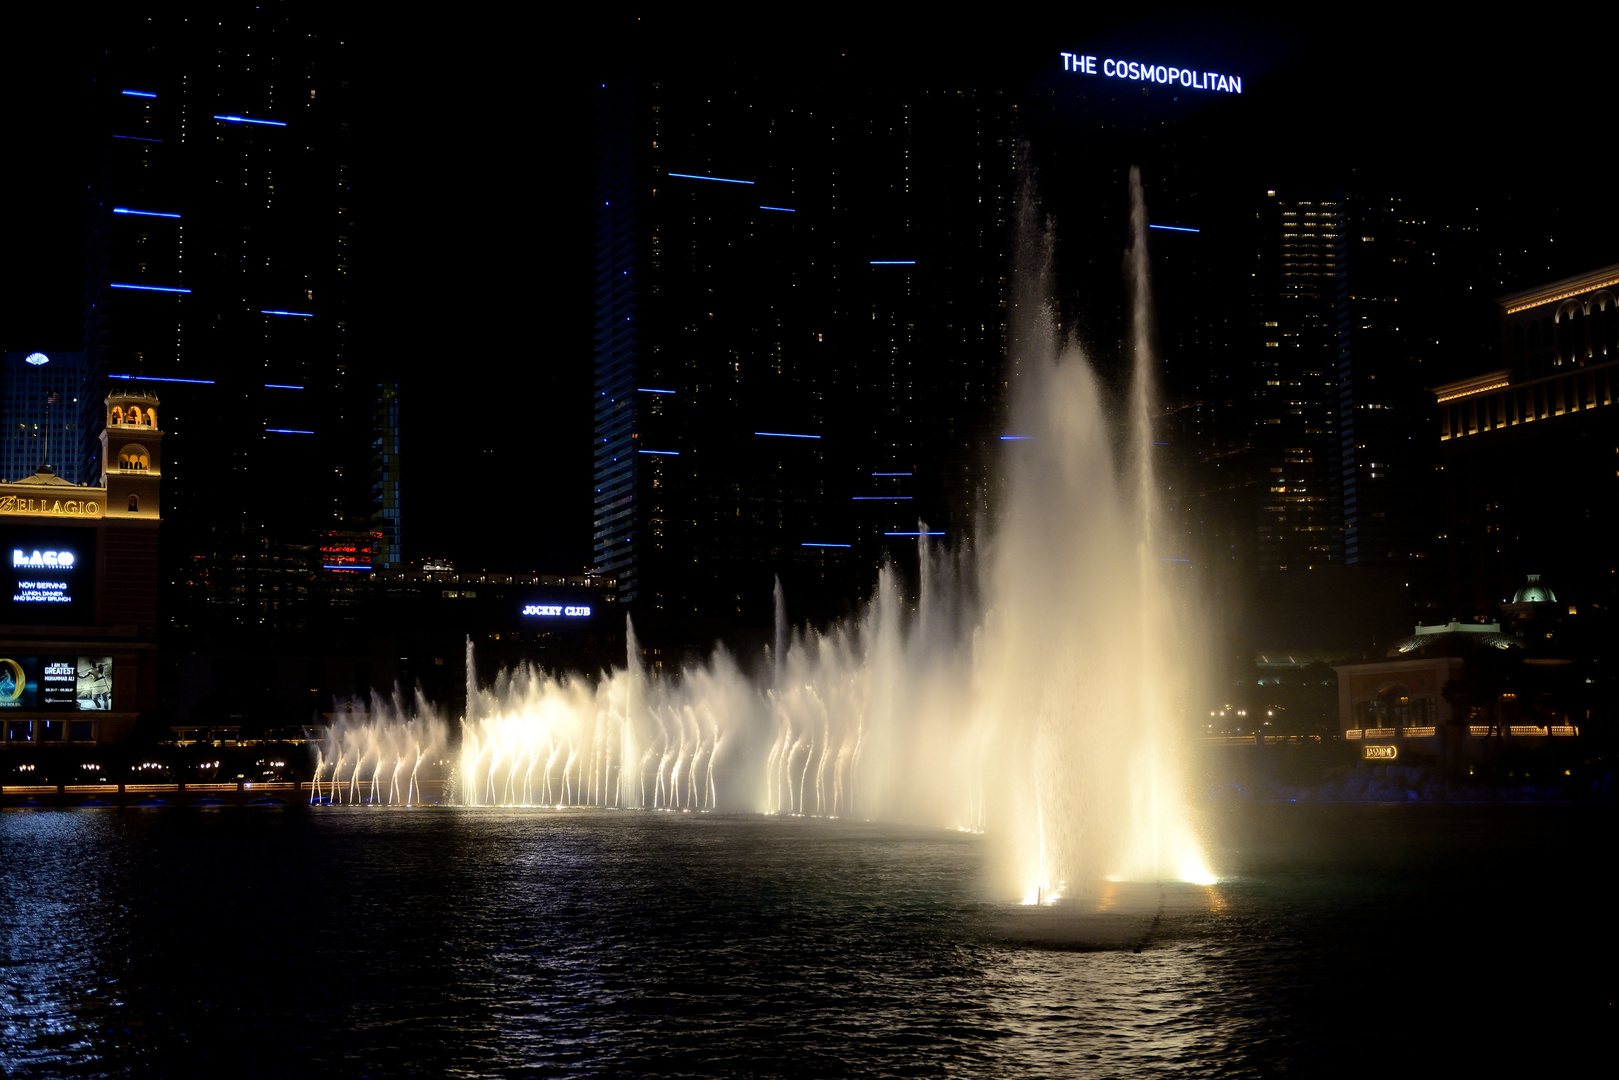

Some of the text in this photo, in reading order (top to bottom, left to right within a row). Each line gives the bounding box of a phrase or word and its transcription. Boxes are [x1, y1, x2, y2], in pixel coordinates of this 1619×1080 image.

[1060, 52, 1242, 94] THE COSMOPOLITAN
[0, 495, 100, 515] BELLAGIO
[13, 549, 75, 565] LAGO
[18, 580, 67, 590] NOW SERVING
[522, 605, 591, 616] JOCKEY CLUB
